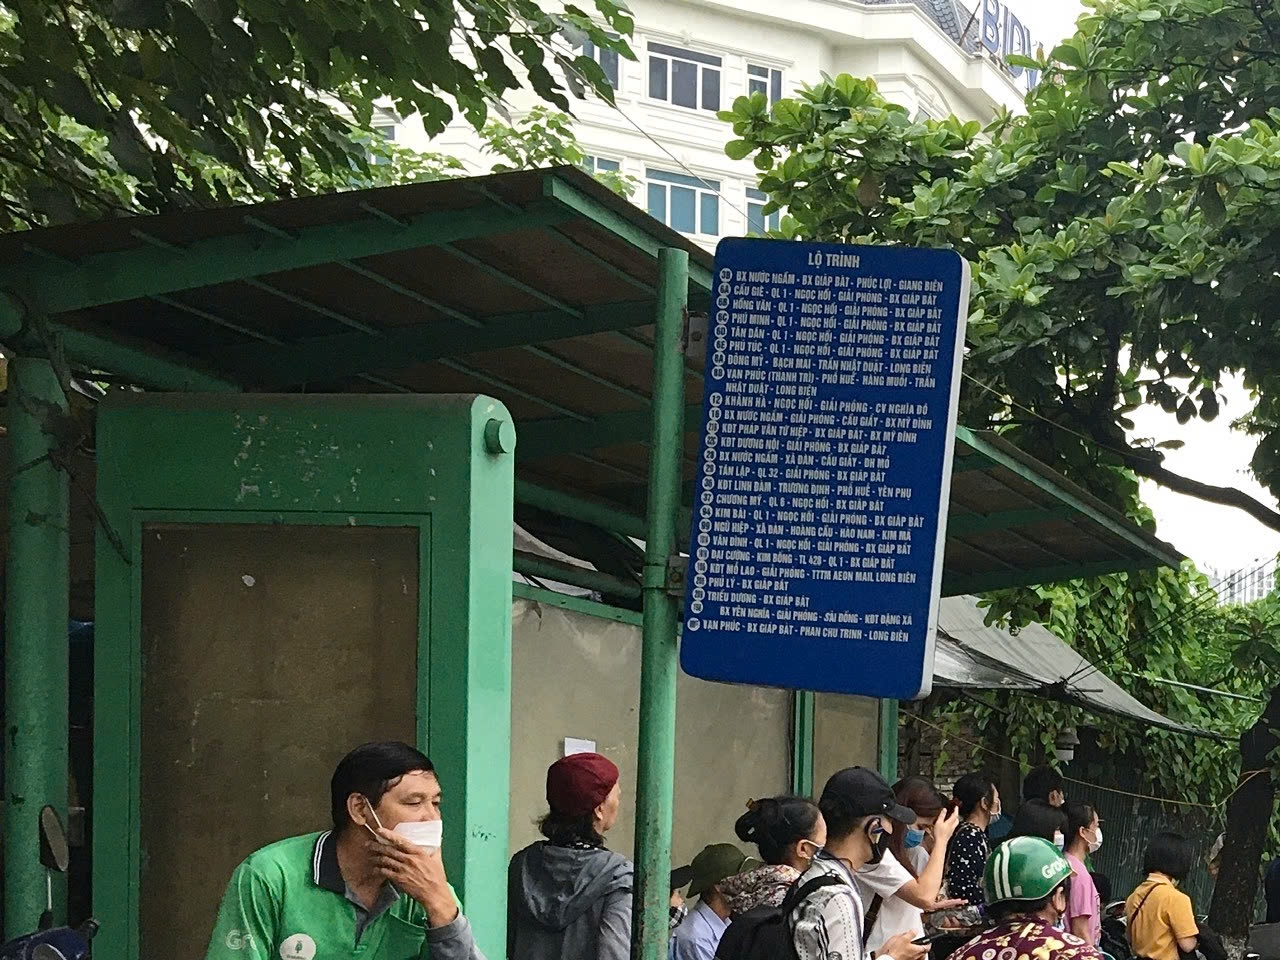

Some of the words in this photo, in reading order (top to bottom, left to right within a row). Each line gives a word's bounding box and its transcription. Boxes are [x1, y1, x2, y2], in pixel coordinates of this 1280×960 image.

[808, 250, 822, 269] LỘ
[826, 251, 860, 268] TRÌNH
[711, 394, 721, 405] 12
[769, 468, 778, 478] 32
